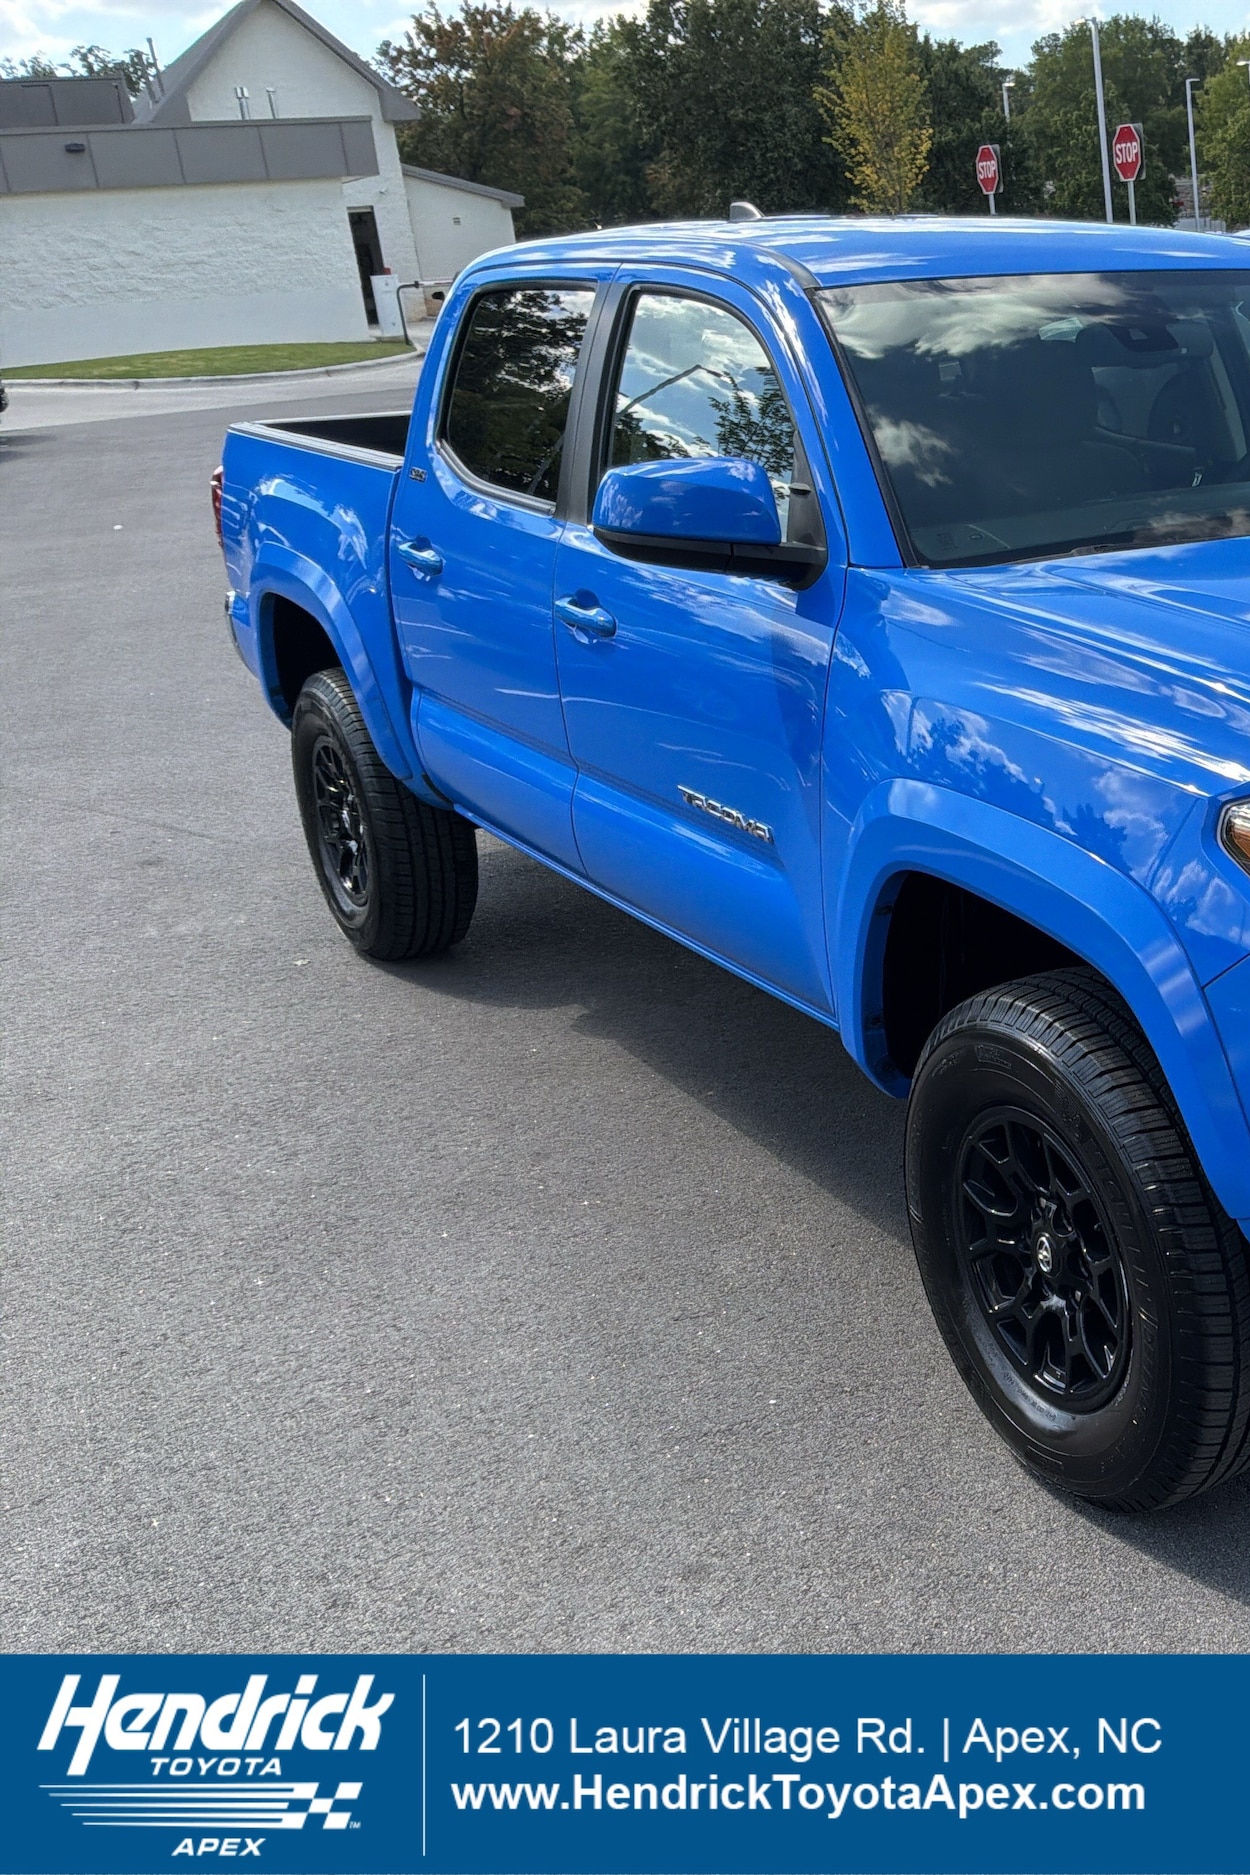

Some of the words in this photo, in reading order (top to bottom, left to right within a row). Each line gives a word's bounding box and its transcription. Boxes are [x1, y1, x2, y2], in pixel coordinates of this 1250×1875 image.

[1115, 141, 1138, 164] STOP
[978, 160, 996, 179] STOP
[677, 784, 774, 844] TACOMA
